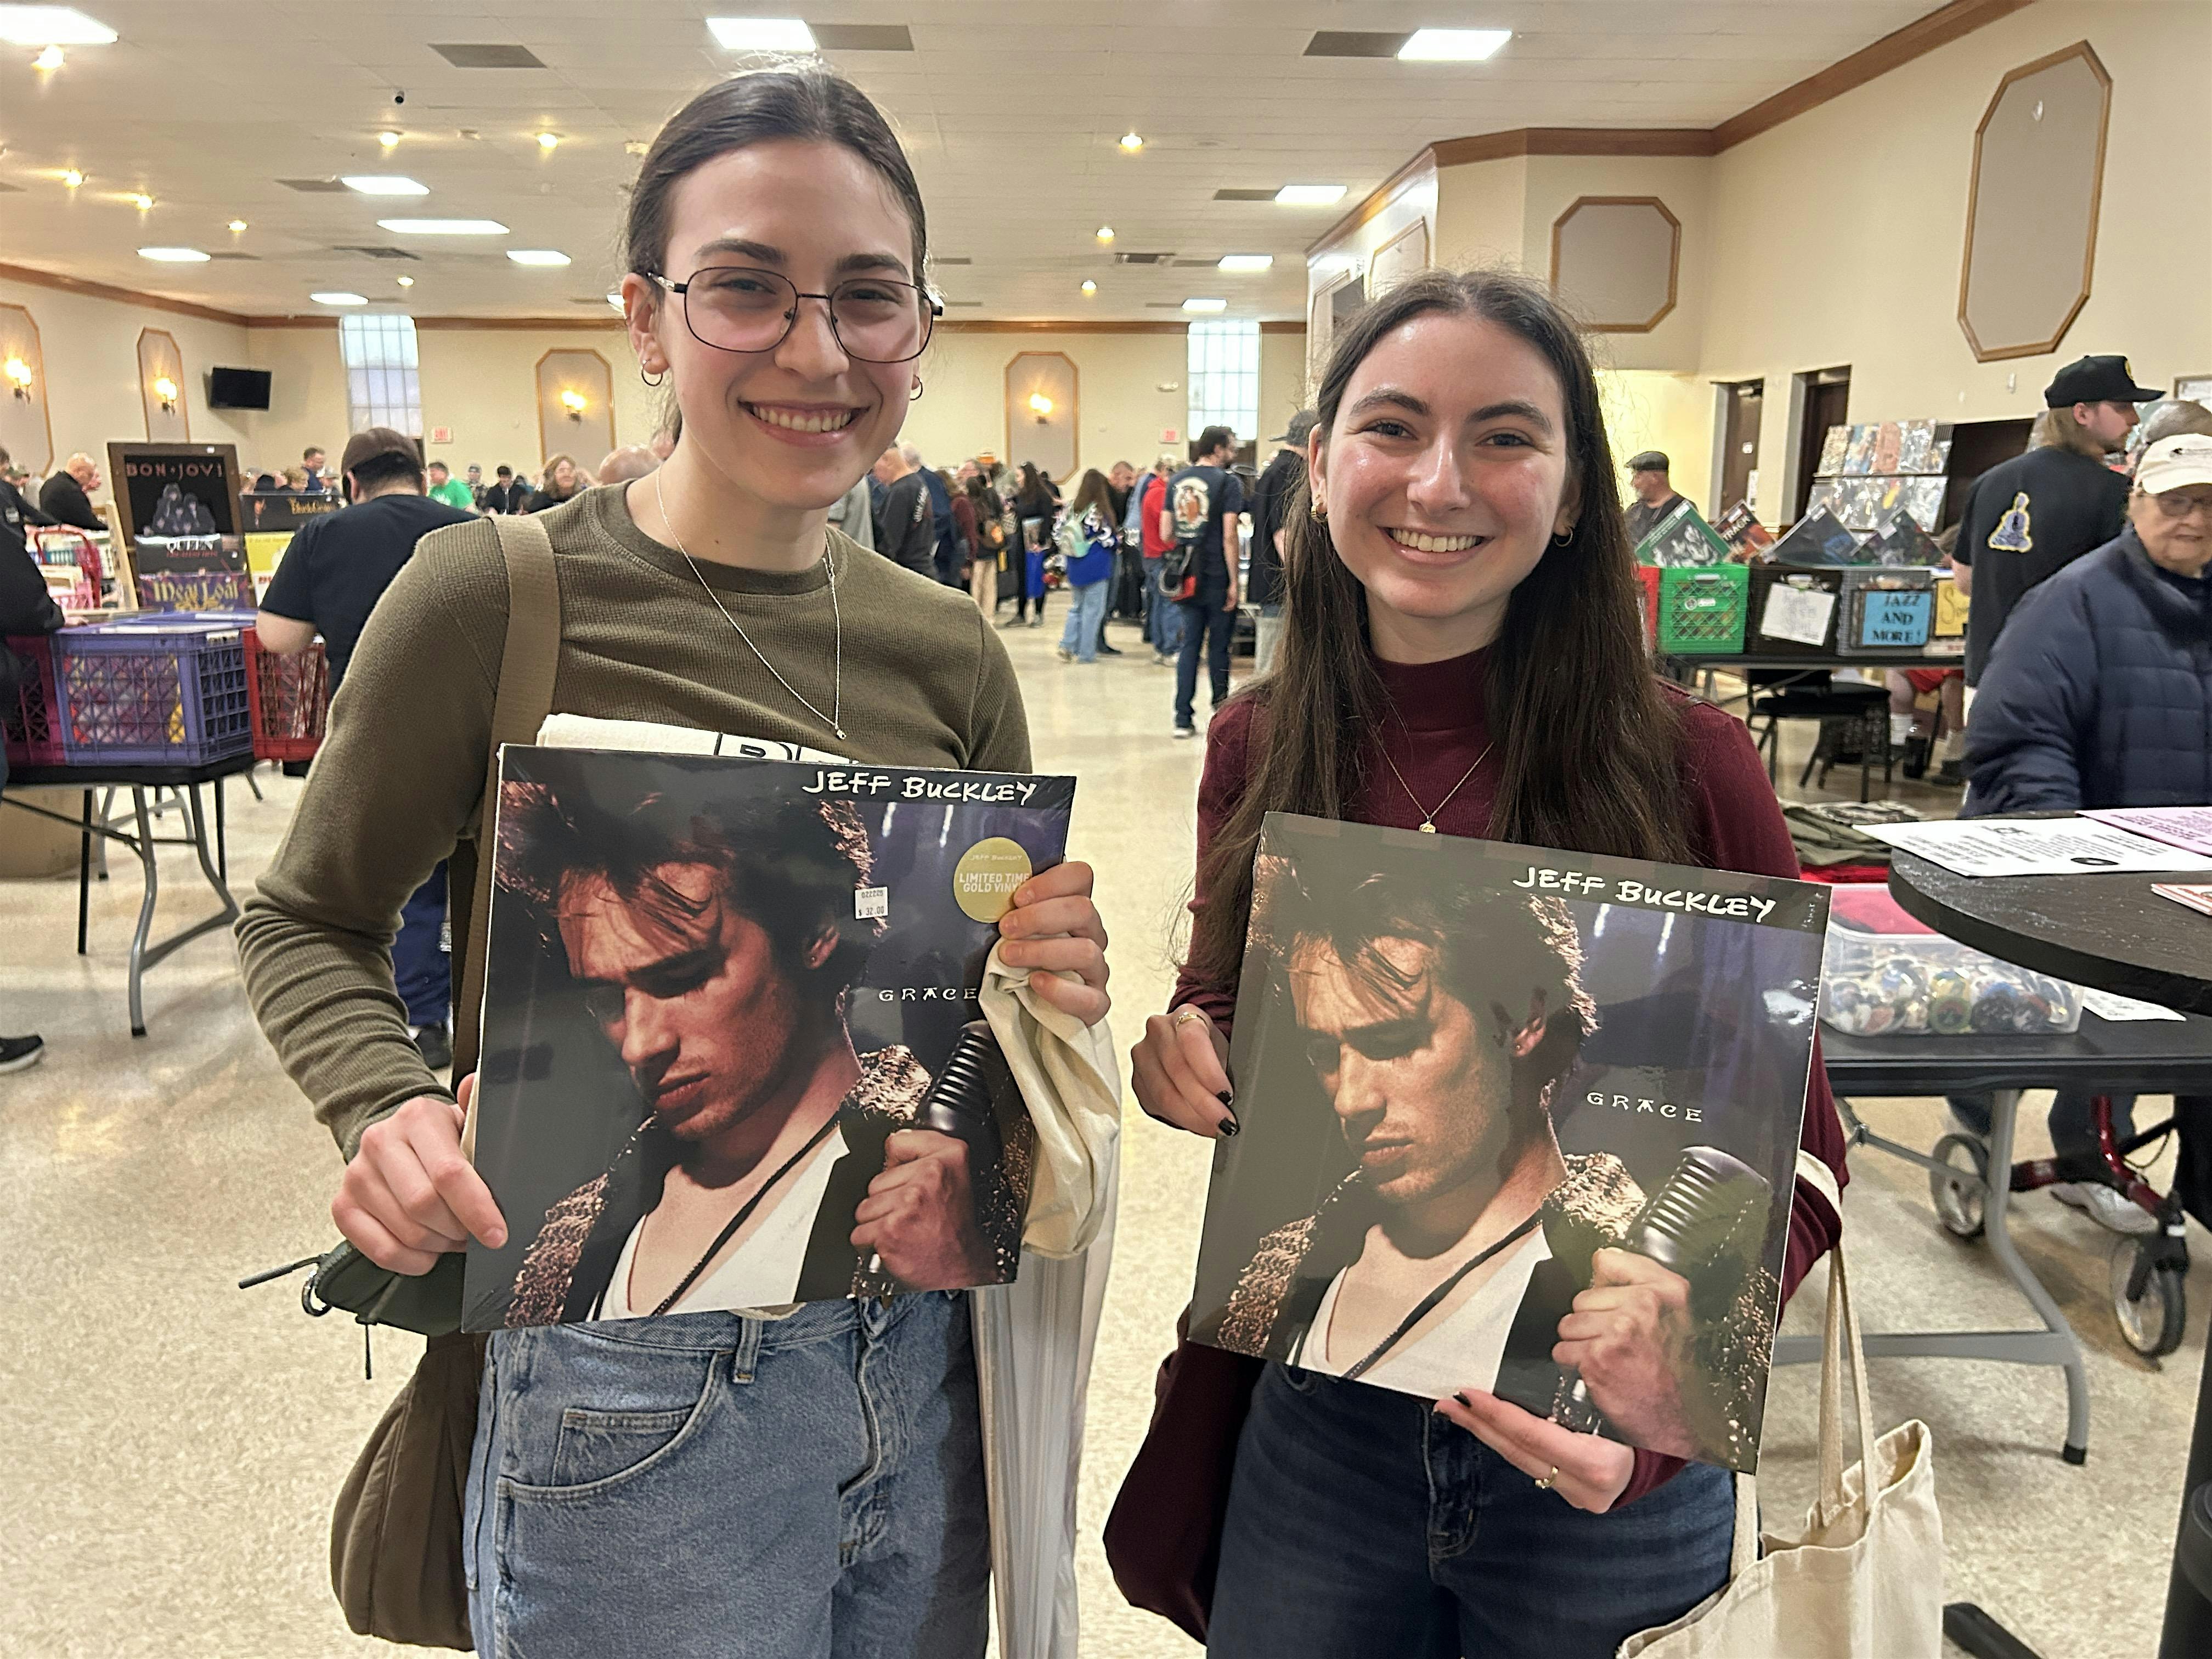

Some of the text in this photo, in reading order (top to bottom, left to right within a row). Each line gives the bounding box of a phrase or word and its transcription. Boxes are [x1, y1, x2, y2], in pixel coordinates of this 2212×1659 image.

[1884, 595, 1920, 607] JAZZ
[1882, 612, 1914, 625] AND
[802, 771, 1037, 805] JEFF BUCKLEY
[959, 873, 1002, 883] LIMITED
[963, 883, 1021, 893] GOLD VINY
[1513, 867, 1776, 923] JEFF BUCKLEY
[858, 909, 862, 917] $
[878, 988, 977, 1002] GRACE
[1587, 1092, 1702, 1123] GRACE
